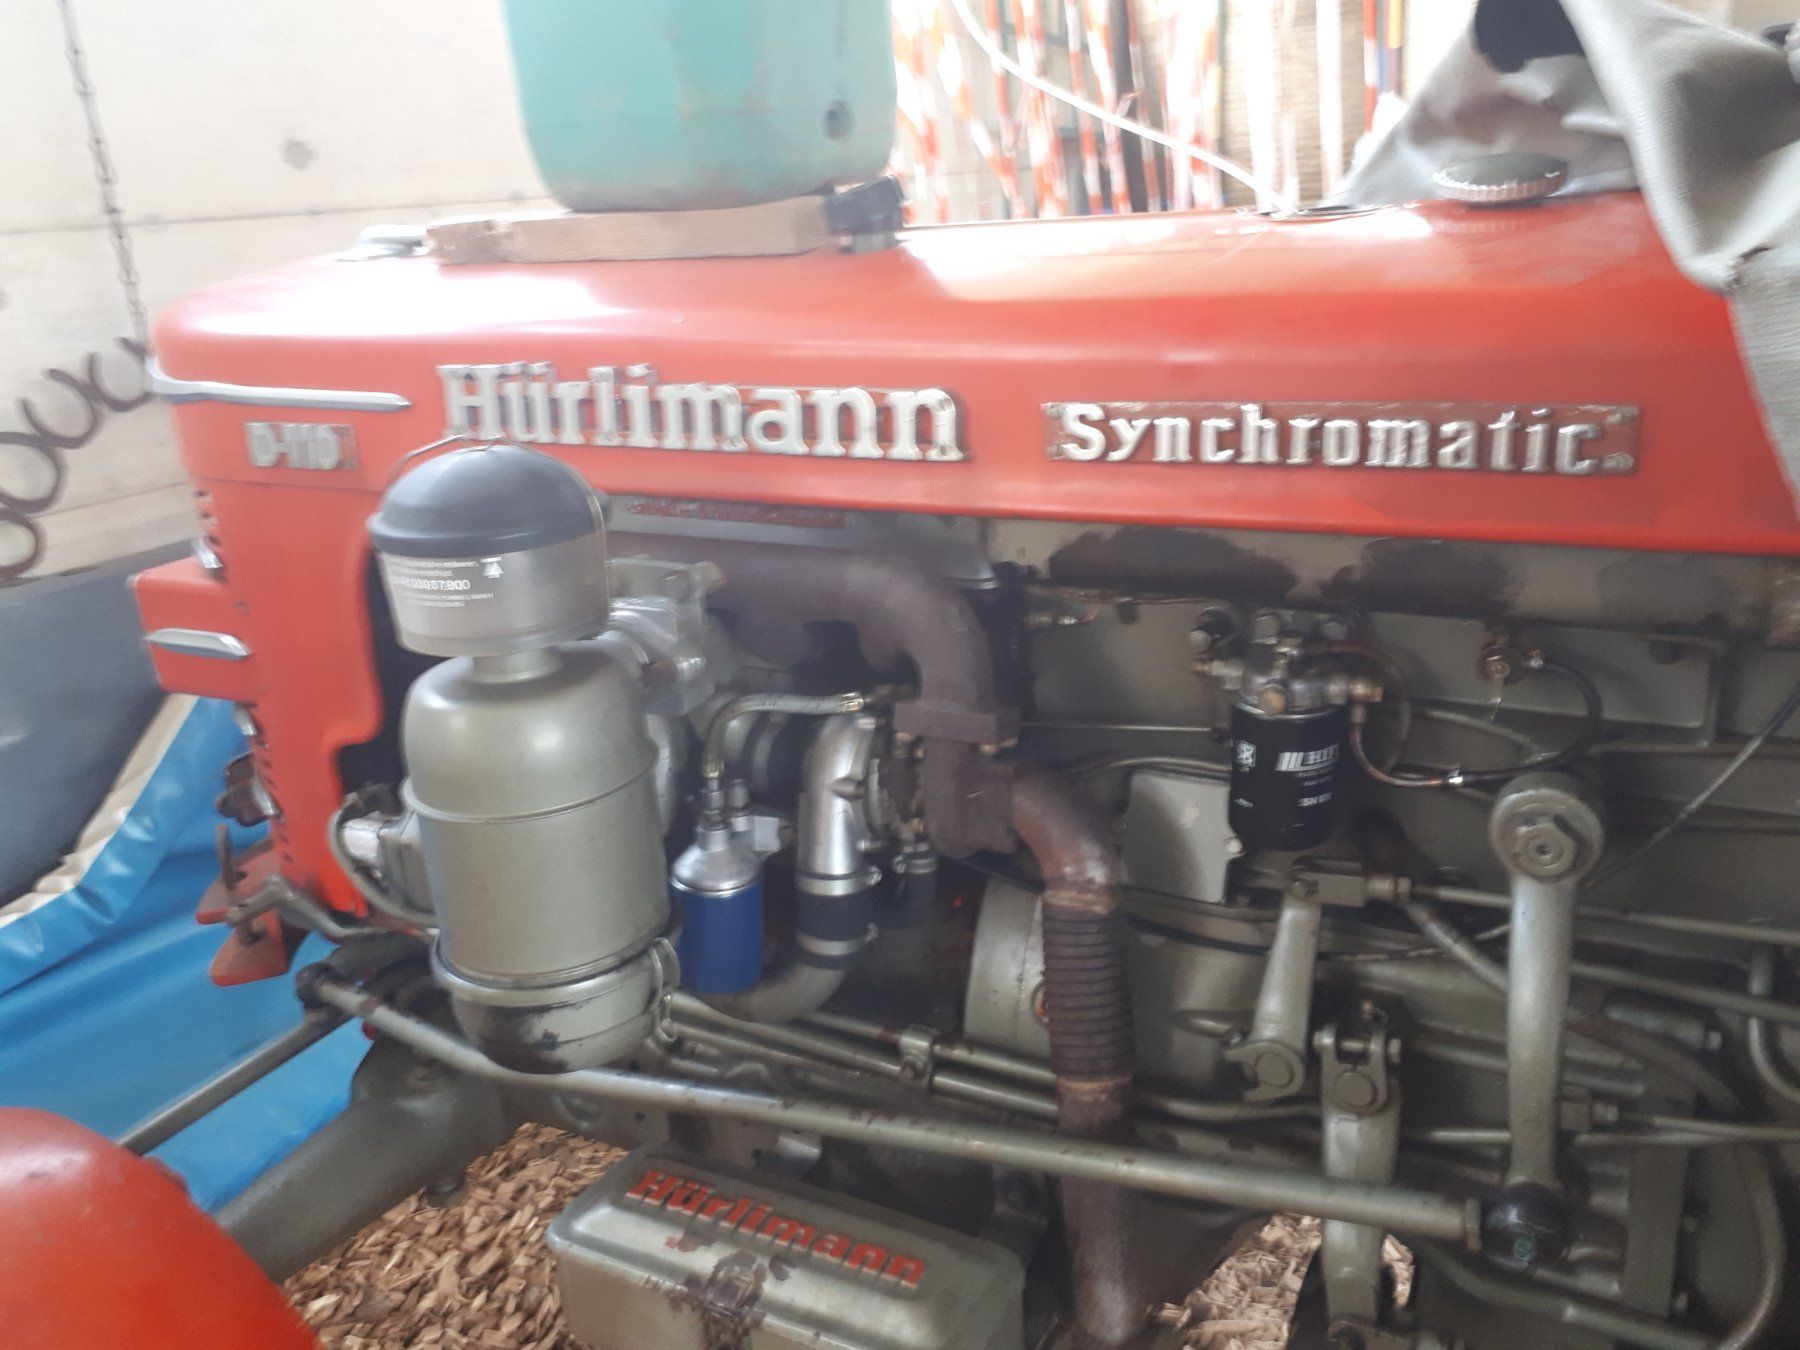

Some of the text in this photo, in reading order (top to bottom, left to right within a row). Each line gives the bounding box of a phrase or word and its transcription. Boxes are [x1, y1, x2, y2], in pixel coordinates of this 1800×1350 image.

[437, 361, 967, 462] Hürlimann
[1060, 402, 1602, 475] Synchromatic
[625, 1169, 926, 1289] Hürlimann
